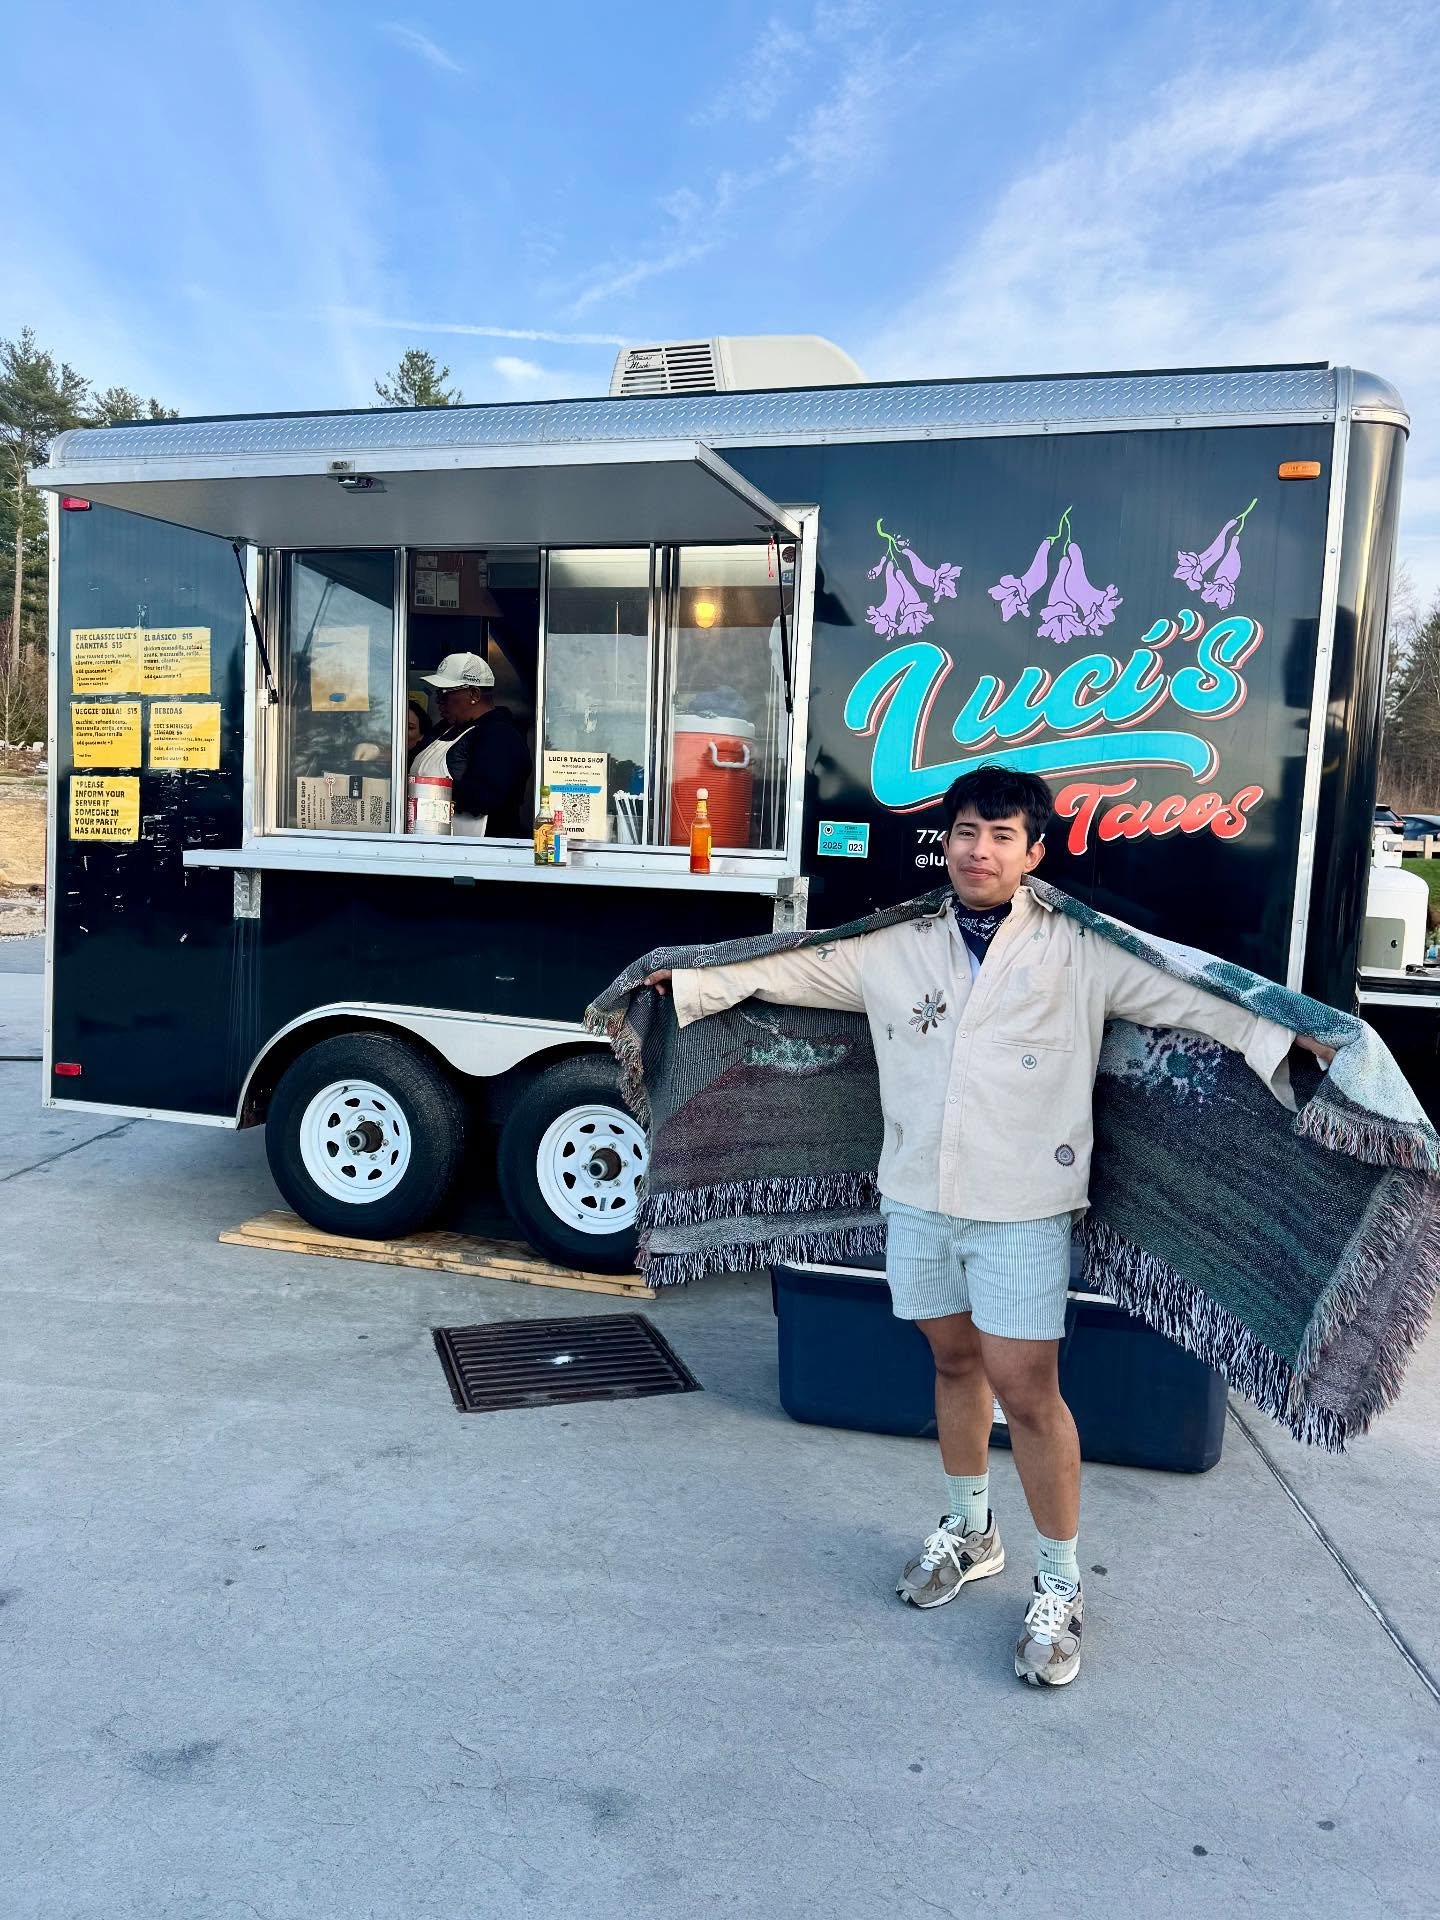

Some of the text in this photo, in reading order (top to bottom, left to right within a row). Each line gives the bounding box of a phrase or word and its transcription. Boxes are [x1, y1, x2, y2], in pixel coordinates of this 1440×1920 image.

[152, 633, 177, 641] BÁSICO
[127, 707, 138, 715] $15
[154, 707, 182, 715] BEBIDAS
[75, 790, 125, 798] INFORM YOUR
[75, 799, 110, 807] SERVER IF
[75, 808, 119, 817] SOMEONE IN
[1054, 777, 1264, 855] Tacos
[75, 827, 89, 835] HAS
[822, 841, 843, 850] 2025
[848, 843, 863, 852] 023
